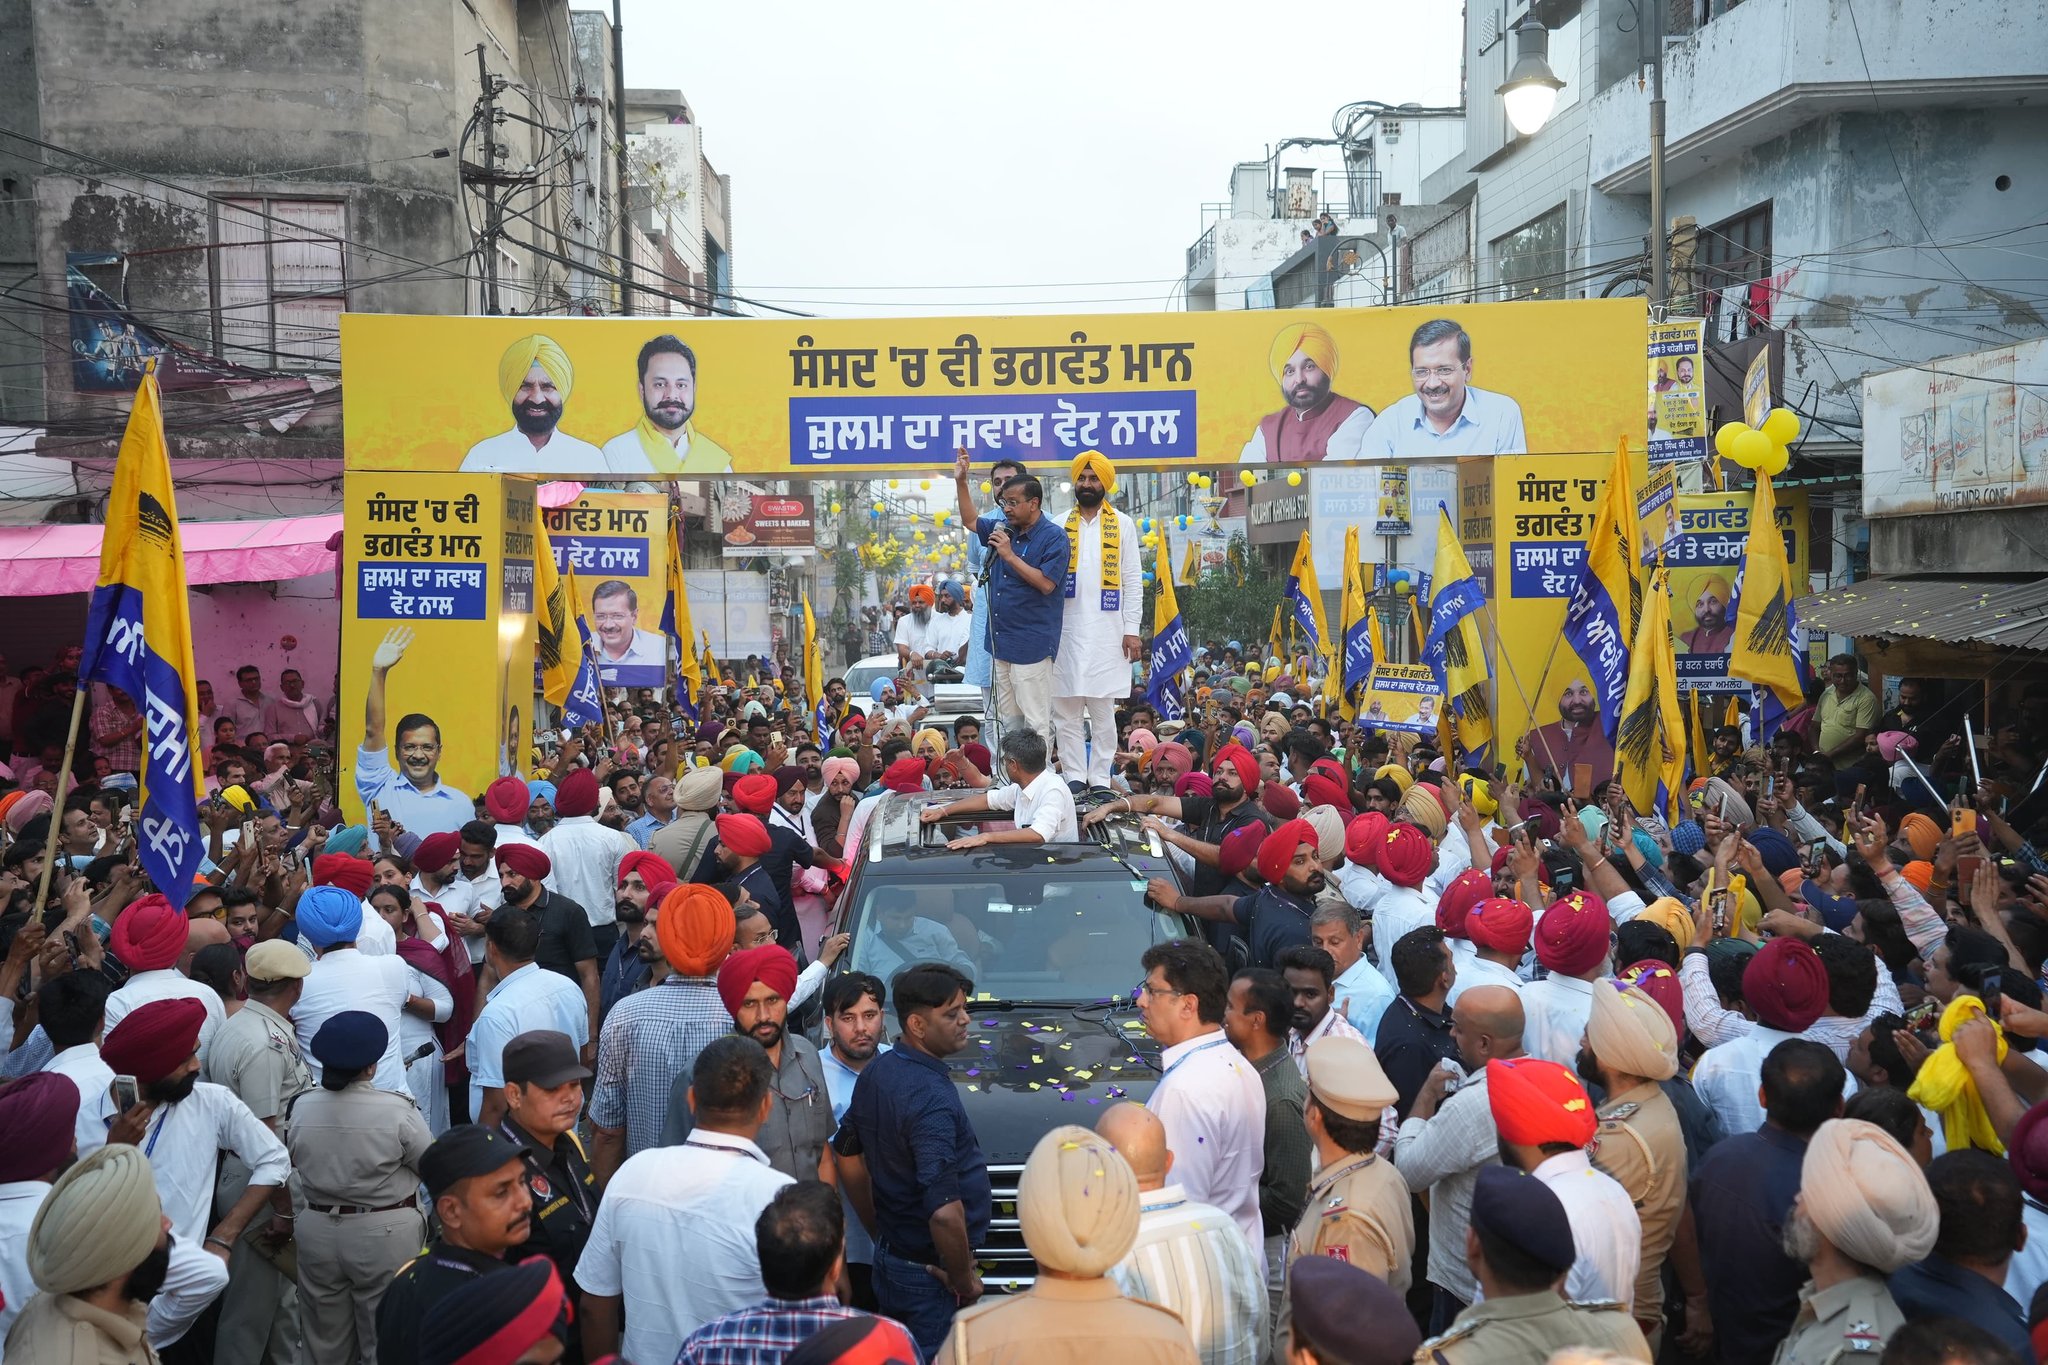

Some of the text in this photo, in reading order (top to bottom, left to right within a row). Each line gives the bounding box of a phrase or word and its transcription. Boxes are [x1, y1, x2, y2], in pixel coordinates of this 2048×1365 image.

[789, 331, 1195, 388] ਸੰਸਦ 'ਚ ਵੀ ਭਗਵੰਤ ਮਾਨ
[806, 398, 1181, 459] ਜ਼ੁਲਮ ਦਾ ਜਵਾਬ ਵੋਟ ਨਾਲ
[1517, 473, 1597, 502] ਸੰਸਦ 'ਚ
[367, 492, 480, 523] ਸੰਸਦ 'ਚ ਵੀ
[608, 508, 648, 532] ਮਾਨ
[1298, 494, 1310, 520] STO
[1515, 506, 1583, 536] ਭਗਵੰਤ
[1680, 500, 1748, 529] ਭਗਵੰਤ
[364, 527, 482, 558] ਭਗਵੰਤ ਮਾਨ
[568, 538, 596, 568] ਵੋਟ
[600, 548, 640, 569] ਨਾਲ
[1685, 536, 1698, 560] ਤੇ
[1515, 548, 1582, 571] ਜ਼ੁਲਮ ਦਾ
[363, 568, 482, 592] ਜ਼ੁਲਮ ਦਾ ਜਵਾਬ
[1542, 568, 1566, 594] ਵੋਟ
[390, 588, 454, 616] ਵੋਟ ਨਾਲ
[1586, 612, 1623, 682] ਆਦਮੀ
[1376, 665, 1430, 680] ਸੰਸਦ 'ਚ ਵੀ ਭਗਵੰਤ
[1686, 660, 1702, 670] ਬਟਨ
[1704, 656, 1724, 670] ਦਬਾਓ
[1716, 678, 1742, 689] ਅਮਲੋਹ
